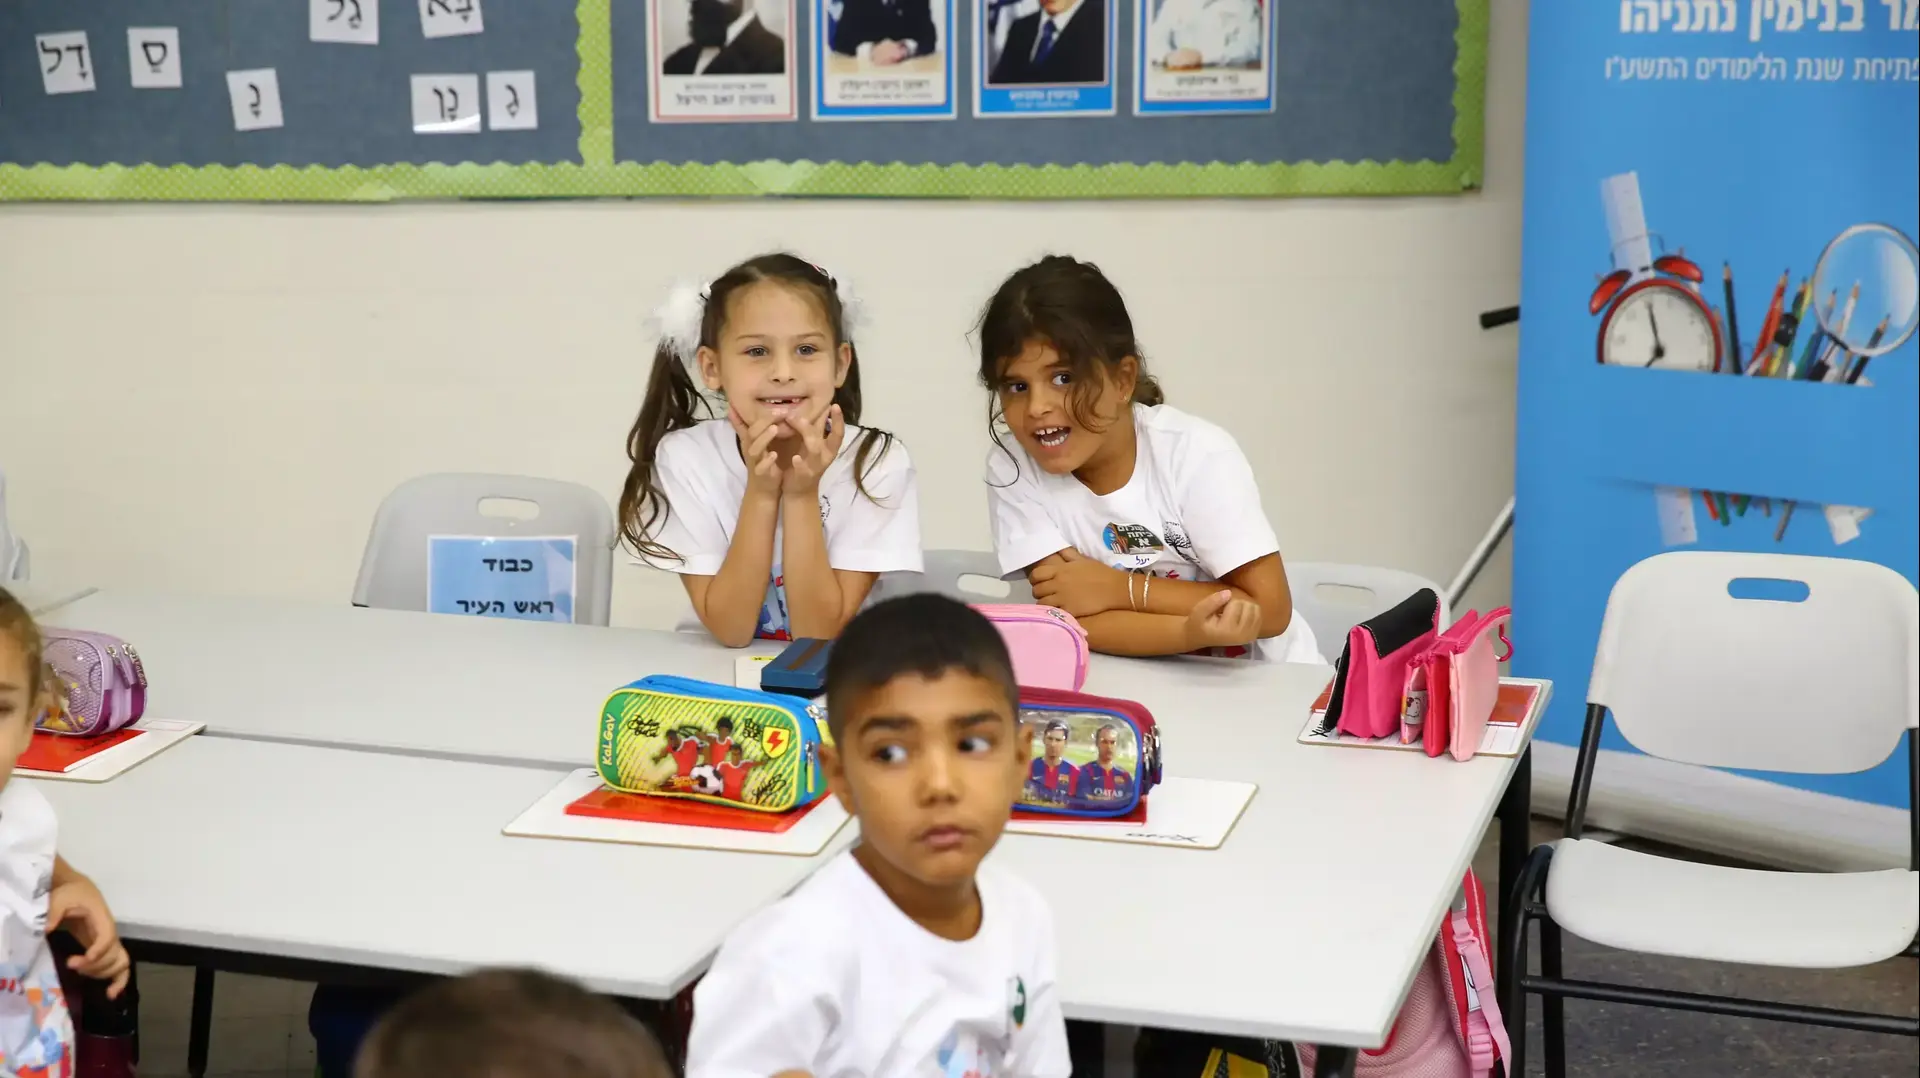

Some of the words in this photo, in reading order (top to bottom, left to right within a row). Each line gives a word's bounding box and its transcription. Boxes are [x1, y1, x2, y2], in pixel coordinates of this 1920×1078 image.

[1620, 0, 1736, 32] נתניהו
[1749, 0, 1864, 41] בנימין
[1696, 52, 1787, 80] הלימודים
[1795, 57, 1844, 81] שנת
[482, 558, 534, 572] כבוד
[456, 599, 505, 615] העיר
[514, 600, 554, 614] ראש
